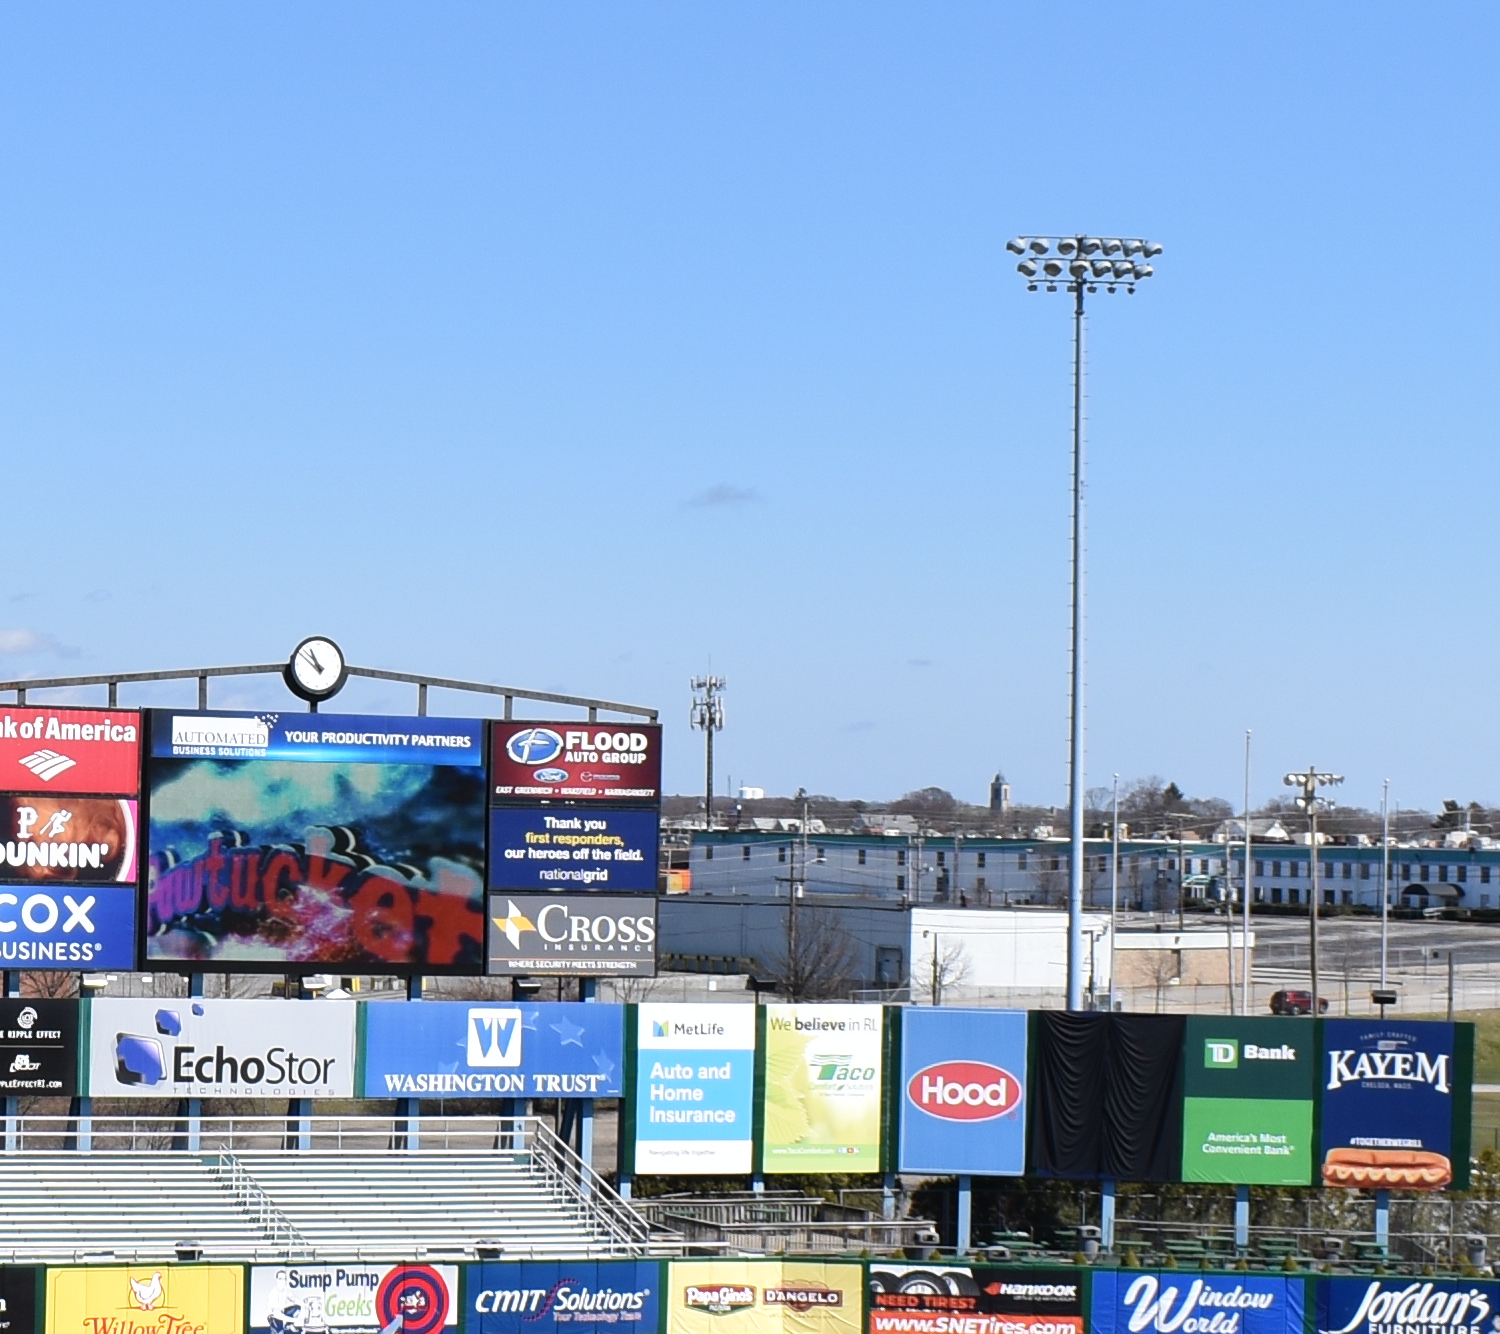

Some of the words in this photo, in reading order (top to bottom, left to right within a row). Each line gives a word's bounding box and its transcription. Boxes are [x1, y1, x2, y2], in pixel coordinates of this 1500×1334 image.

[20, 717, 44, 739] of
[45, 718, 136, 742] America
[175, 732, 267, 744] AUTOMATED
[285, 731, 319, 743] YOUR
[322, 732, 409, 745] PRODUCTIVITY
[412, 736, 470, 747] PARTNERS
[566, 732, 648, 751] FLOOD
[565, 752, 598, 762] AUTO
[602, 753, 646, 764] GROUP
[544, 817, 581, 829] Thank
[584, 819, 606, 831] you
[525, 832, 549, 843] first
[553, 834, 624, 846] responders,
[505, 849, 525, 858] our
[528, 848, 570, 859] heroes
[573, 849, 590, 859] off
[592, 849, 611, 860] the
[614, 849, 643, 860] field.
[539, 868, 608, 883] nationalgrid
[674, 1023, 724, 1035] MetLife
[1207, 1043, 1234, 1063] TD
[1244, 1044, 1296, 1060] Bank
[173, 1045, 335, 1086] EchoStor
[650, 1061, 693, 1080] Auto
[698, 1062, 731, 1080] and
[1327, 1050, 1450, 1093] KAYEM
[384, 1074, 524, 1092] WASHINGTON
[534, 1074, 599, 1092] TRUST
[922, 1077, 1007, 1106] Hood
[650, 1084, 703, 1101] Home
[650, 1106, 736, 1123] Insurance
[288, 1270, 332, 1291] Sump
[336, 1269, 379, 1290] Pump
[325, 1293, 373, 1317] Geeks
[475, 1290, 546, 1313] CMIT
[554, 1287, 643, 1310] Solutions
[687, 1287, 719, 1305] Papa
[720, 1287, 753, 1304] Gino's
[767, 1290, 838, 1302] D'ANGELO
[875, 1295, 920, 1307] NEED
[925, 1296, 976, 1309] TIRES?
[1319, 1281, 1489, 1334] Jordan's
